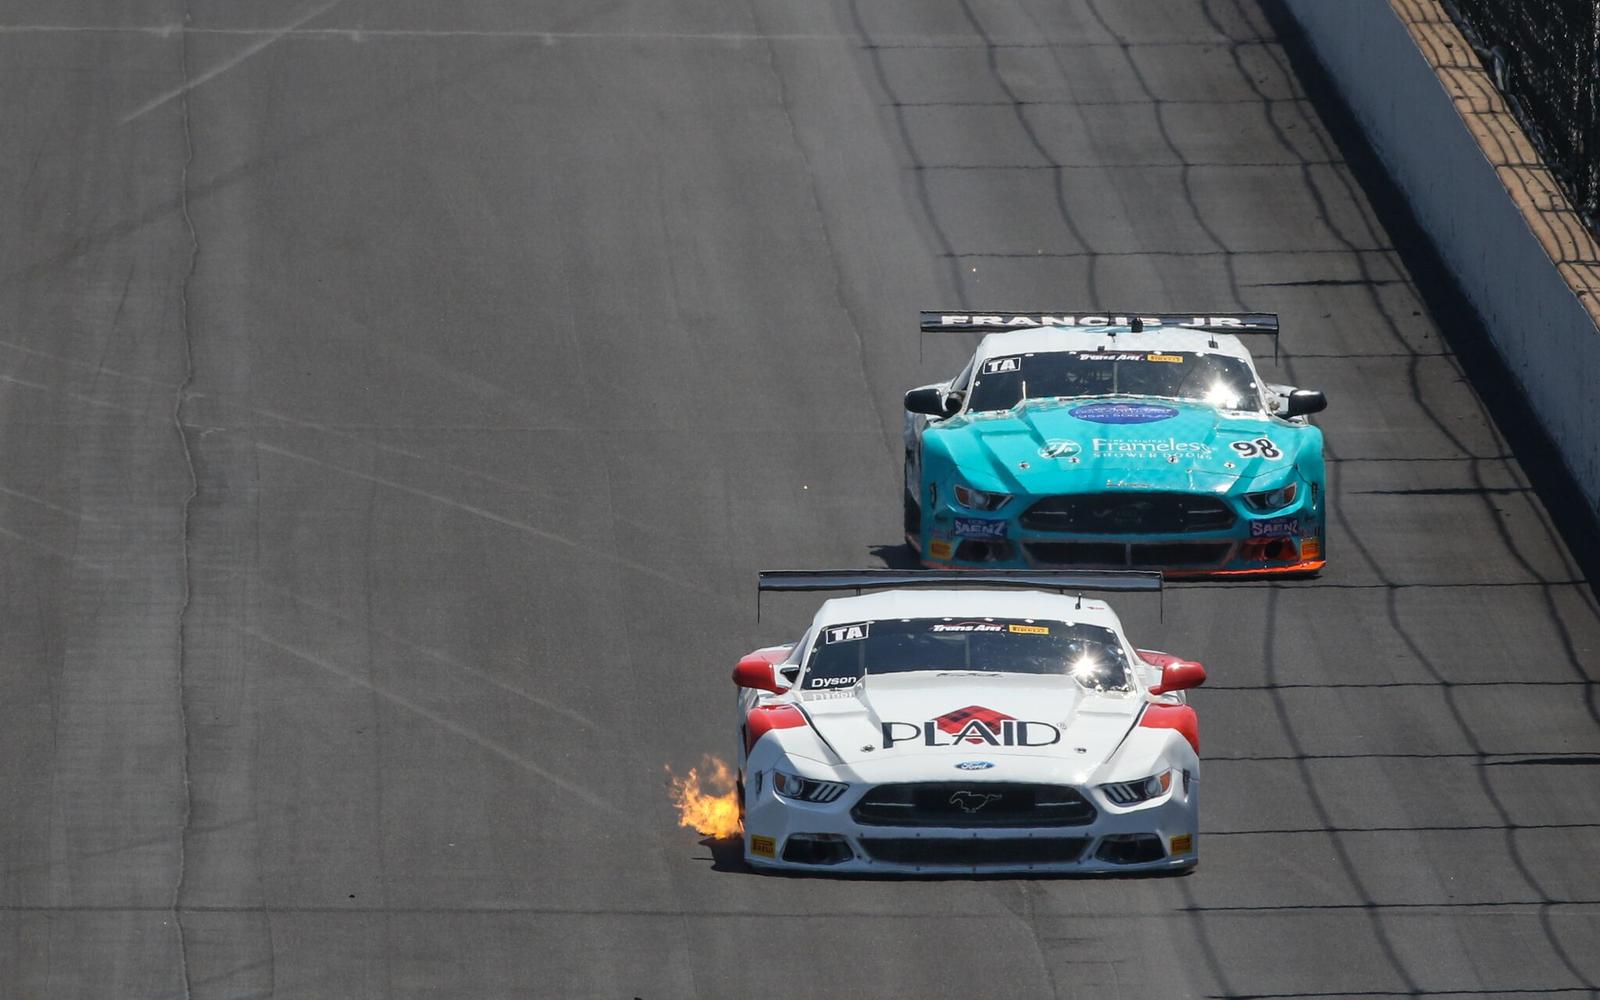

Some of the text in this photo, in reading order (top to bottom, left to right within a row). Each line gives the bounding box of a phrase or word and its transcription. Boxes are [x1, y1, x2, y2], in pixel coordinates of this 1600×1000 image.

[941, 315, 1257, 328] FRANCIS JR.
[988, 359, 1015, 372] TA
[1092, 437, 1212, 454] Frameless
[1231, 438, 1281, 459] 98
[955, 519, 1005, 536] SAENZ
[831, 626, 862, 641] TA
[933, 624, 1001, 632] Trans Am
[811, 676, 857, 688] Dyson
[881, 720, 1061, 749] PLAID
